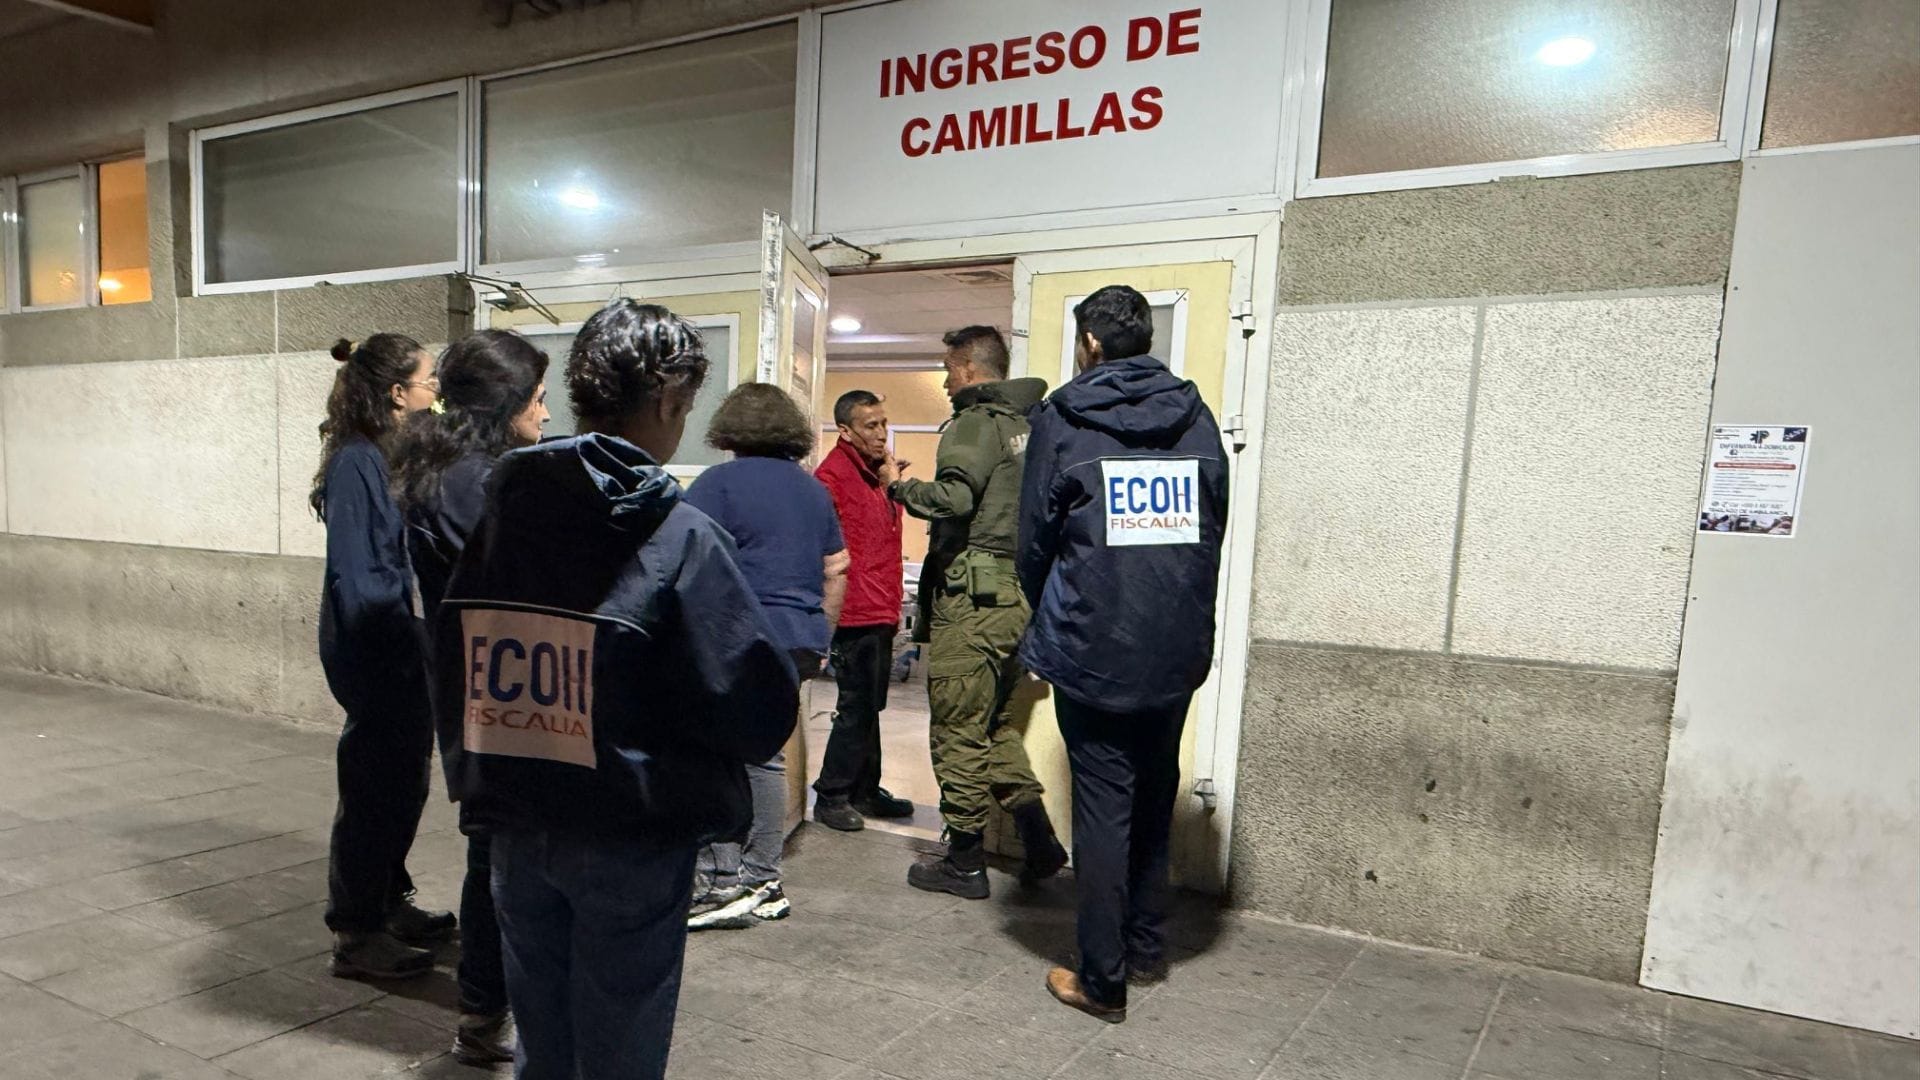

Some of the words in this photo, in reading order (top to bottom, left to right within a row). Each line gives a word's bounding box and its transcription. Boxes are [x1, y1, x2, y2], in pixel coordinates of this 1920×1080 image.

[880, 25, 1106, 98] INGRESO
[1126, 8, 1202, 62] DE
[901, 86, 1163, 158] CAMILLAS
[1109, 477, 1192, 514] ECOH
[1111, 517, 1192, 529] FISCALIA
[471, 636, 587, 715] ECOH
